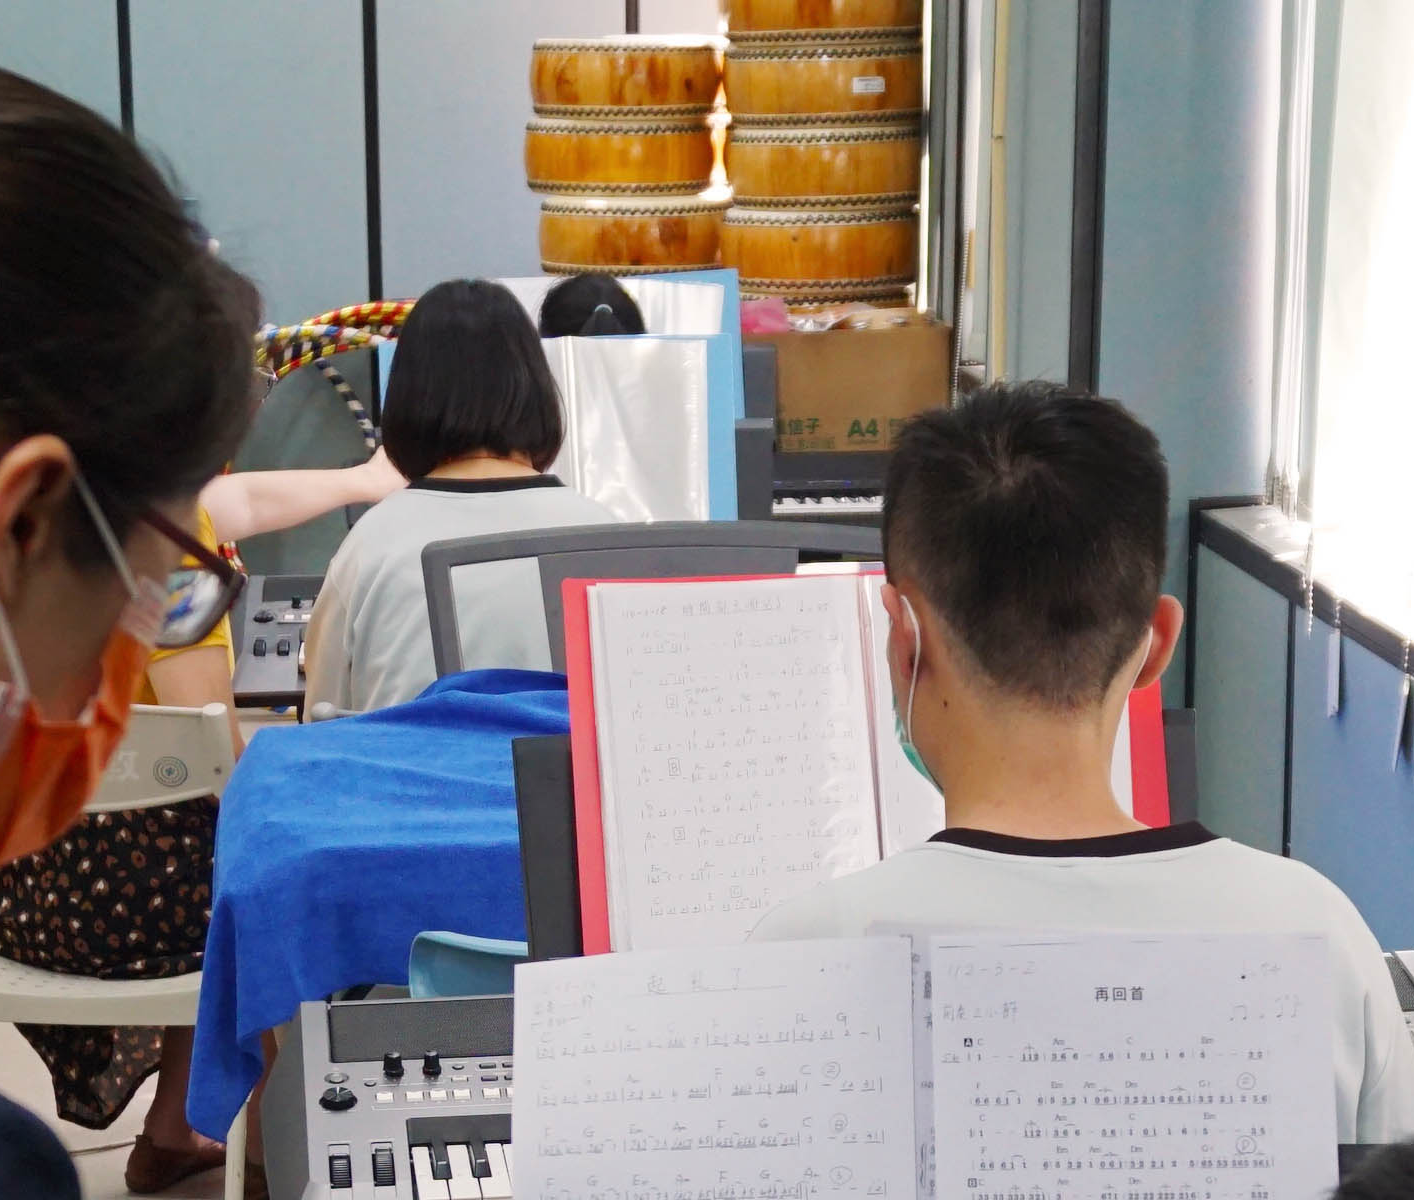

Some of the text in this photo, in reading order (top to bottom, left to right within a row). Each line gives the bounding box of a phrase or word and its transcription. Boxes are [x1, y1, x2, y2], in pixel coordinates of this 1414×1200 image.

[847, 419, 878, 437] A4
[1094, 986, 1145, 1002] 再回首
